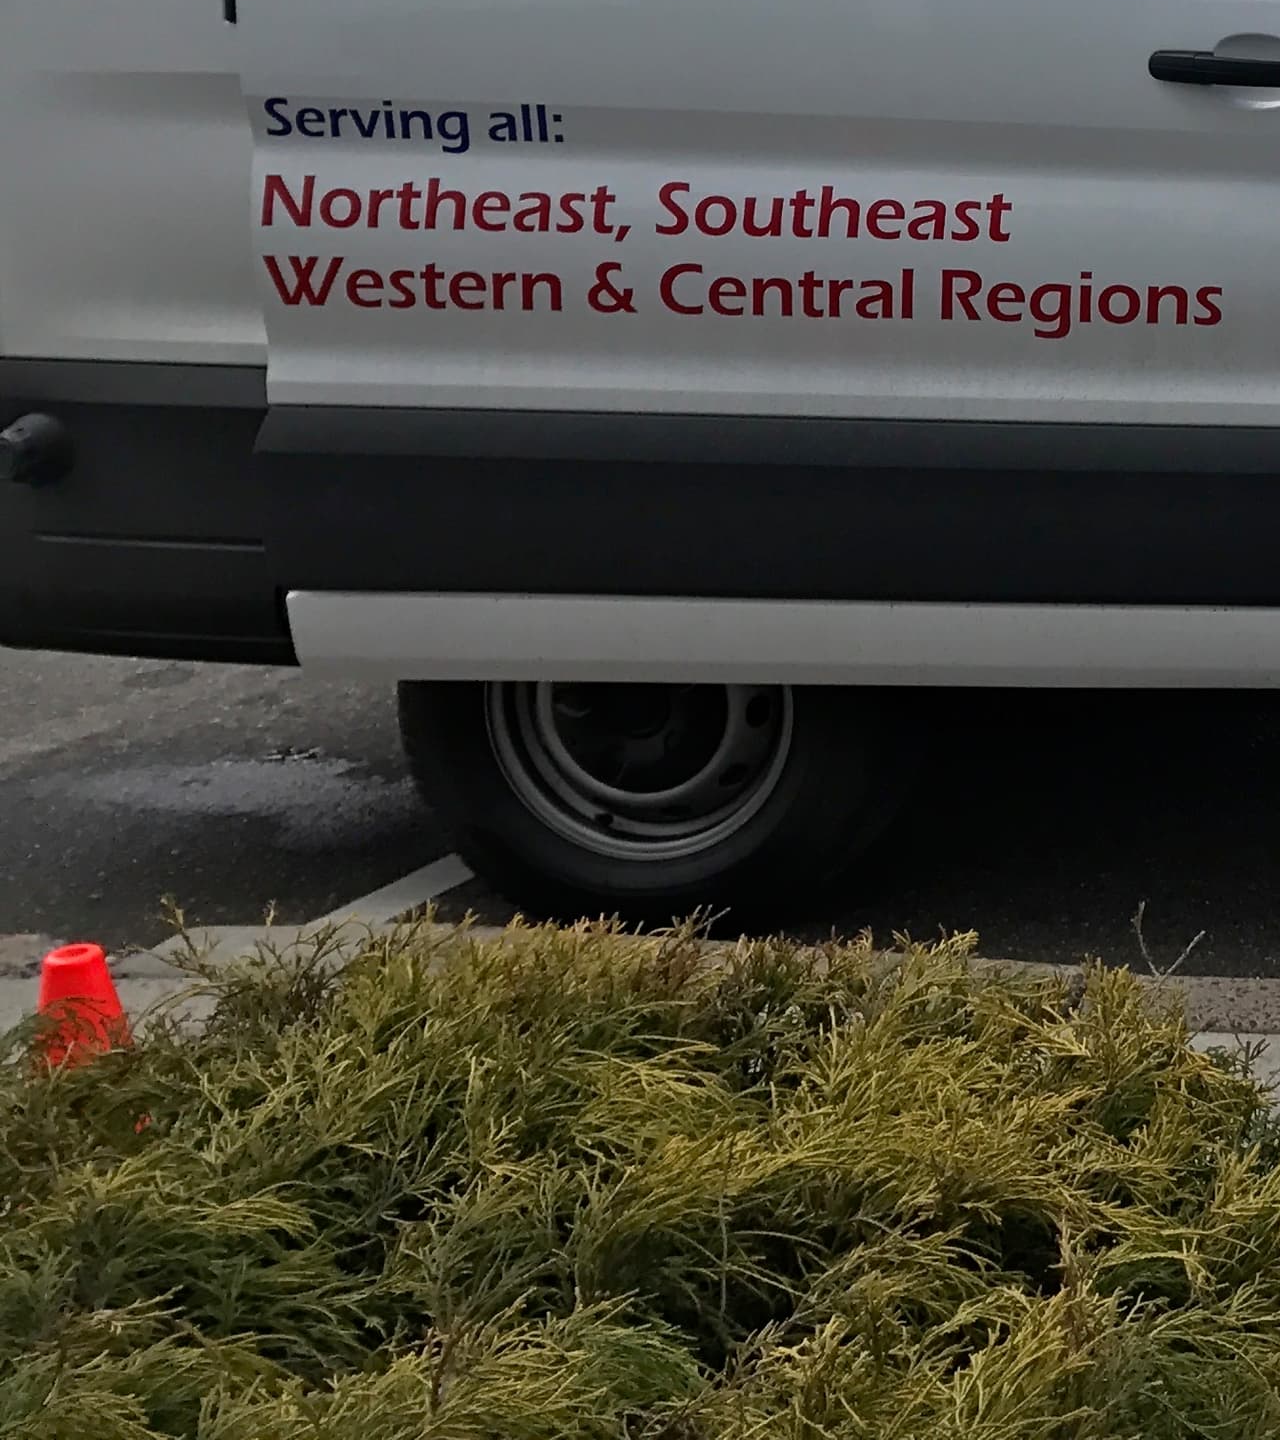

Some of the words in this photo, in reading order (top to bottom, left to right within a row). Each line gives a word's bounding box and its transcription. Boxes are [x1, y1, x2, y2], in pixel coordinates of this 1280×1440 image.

[264, 96, 472, 154] Serving
[488, 102, 566, 144] all:
[262, 173, 633, 243] Northeast,
[654, 181, 1013, 244] Southeast
[266, 255, 563, 311] Western
[588, 262, 635, 314] &
[659, 264, 915, 319] Central
[941, 268, 1225, 340] Regions
